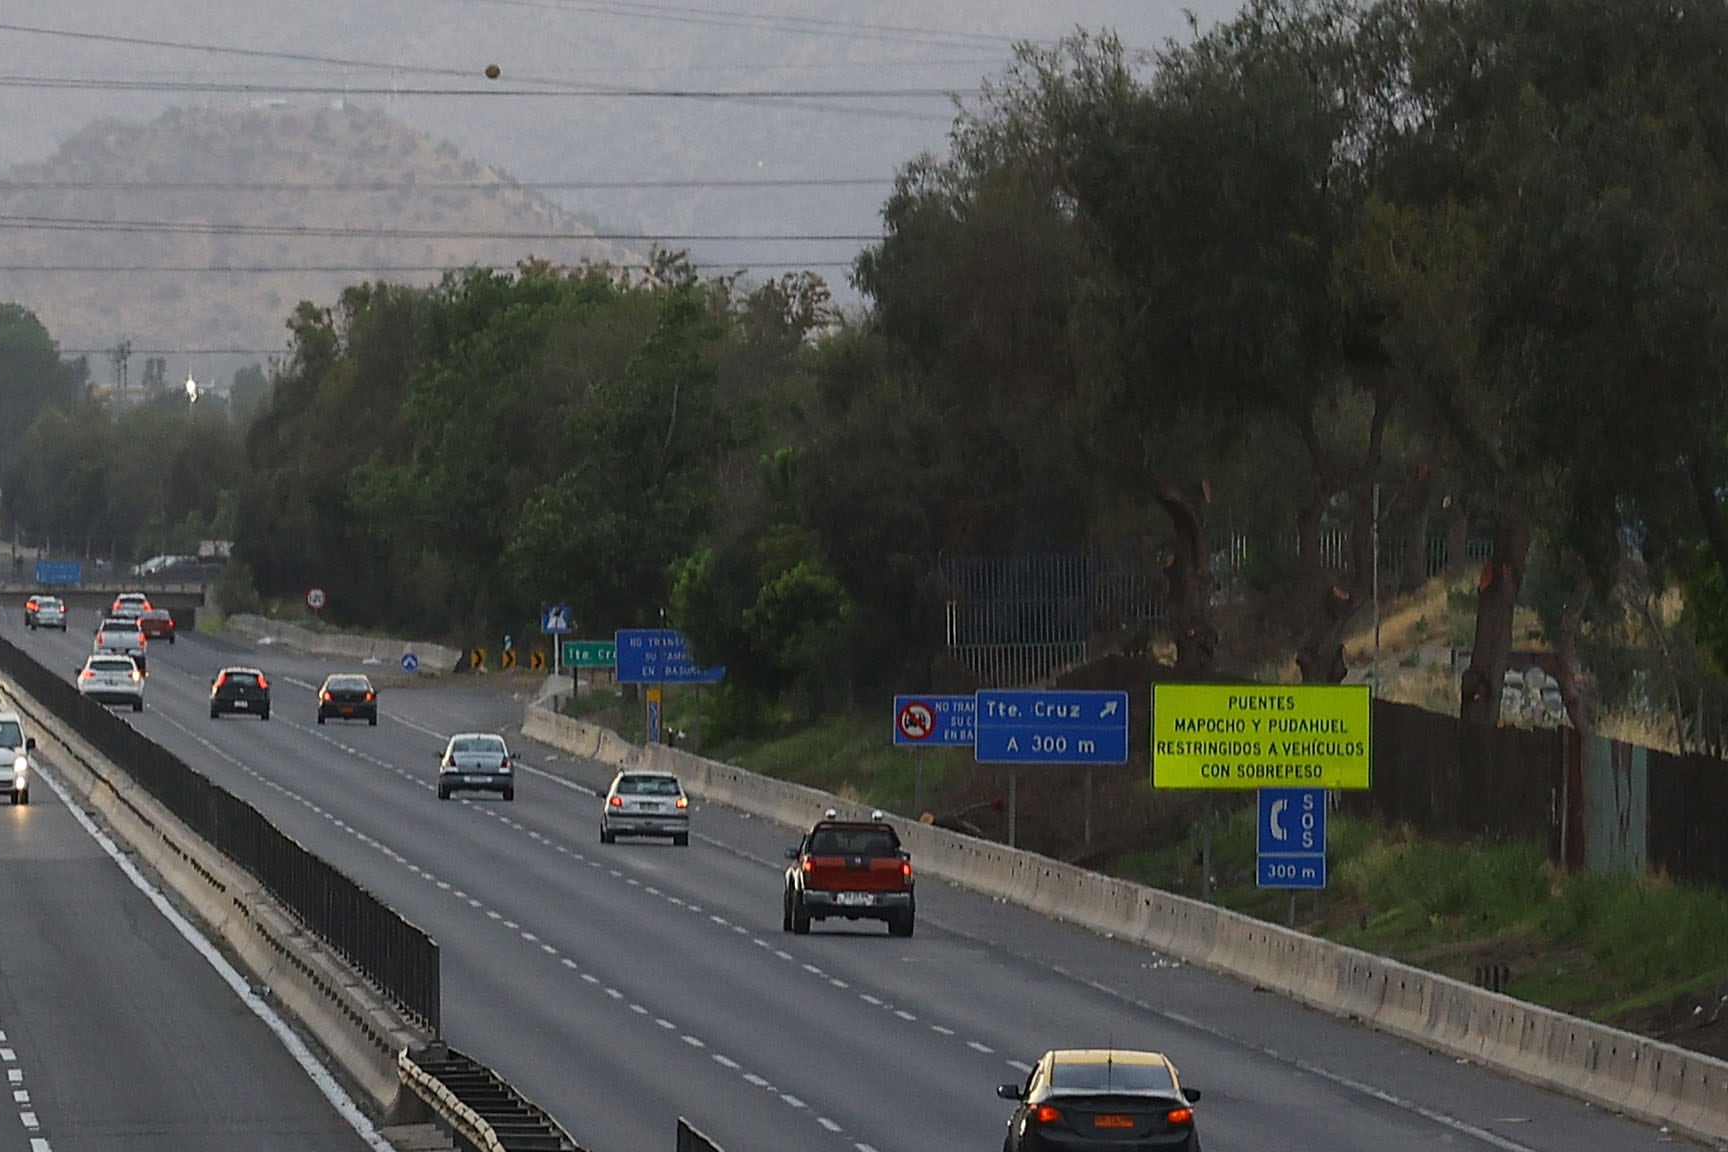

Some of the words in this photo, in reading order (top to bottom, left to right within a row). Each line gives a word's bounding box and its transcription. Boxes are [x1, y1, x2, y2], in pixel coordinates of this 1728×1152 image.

[935, 702, 949, 712] NO
[986, 701, 1023, 718] Tte.
[1034, 701, 1080, 718] Cruz
[1228, 696, 1295, 711] PUENTES
[951, 716, 963, 727] SU
[1175, 718, 1246, 733] MAPOCHO
[1251, 718, 1261, 733] Y
[1268, 718, 1348, 734] PUDAHUEL
[943, 730, 958, 741] EN
[1007, 737, 1019, 752] A
[1032, 736, 1067, 753] 300
[1078, 739, 1095, 753] m
[1157, 741, 1261, 756] RESTRINGIDOS
[1268, 741, 1278, 756] A
[1282, 738, 1364, 757] VEHÍCULOS
[1201, 764, 1230, 778] CON
[1237, 764, 1323, 779] SOBREPESO
[1301, 793, 1314, 848] SOS
[1267, 864, 1296, 878] 300
[1302, 868, 1316, 879] m
